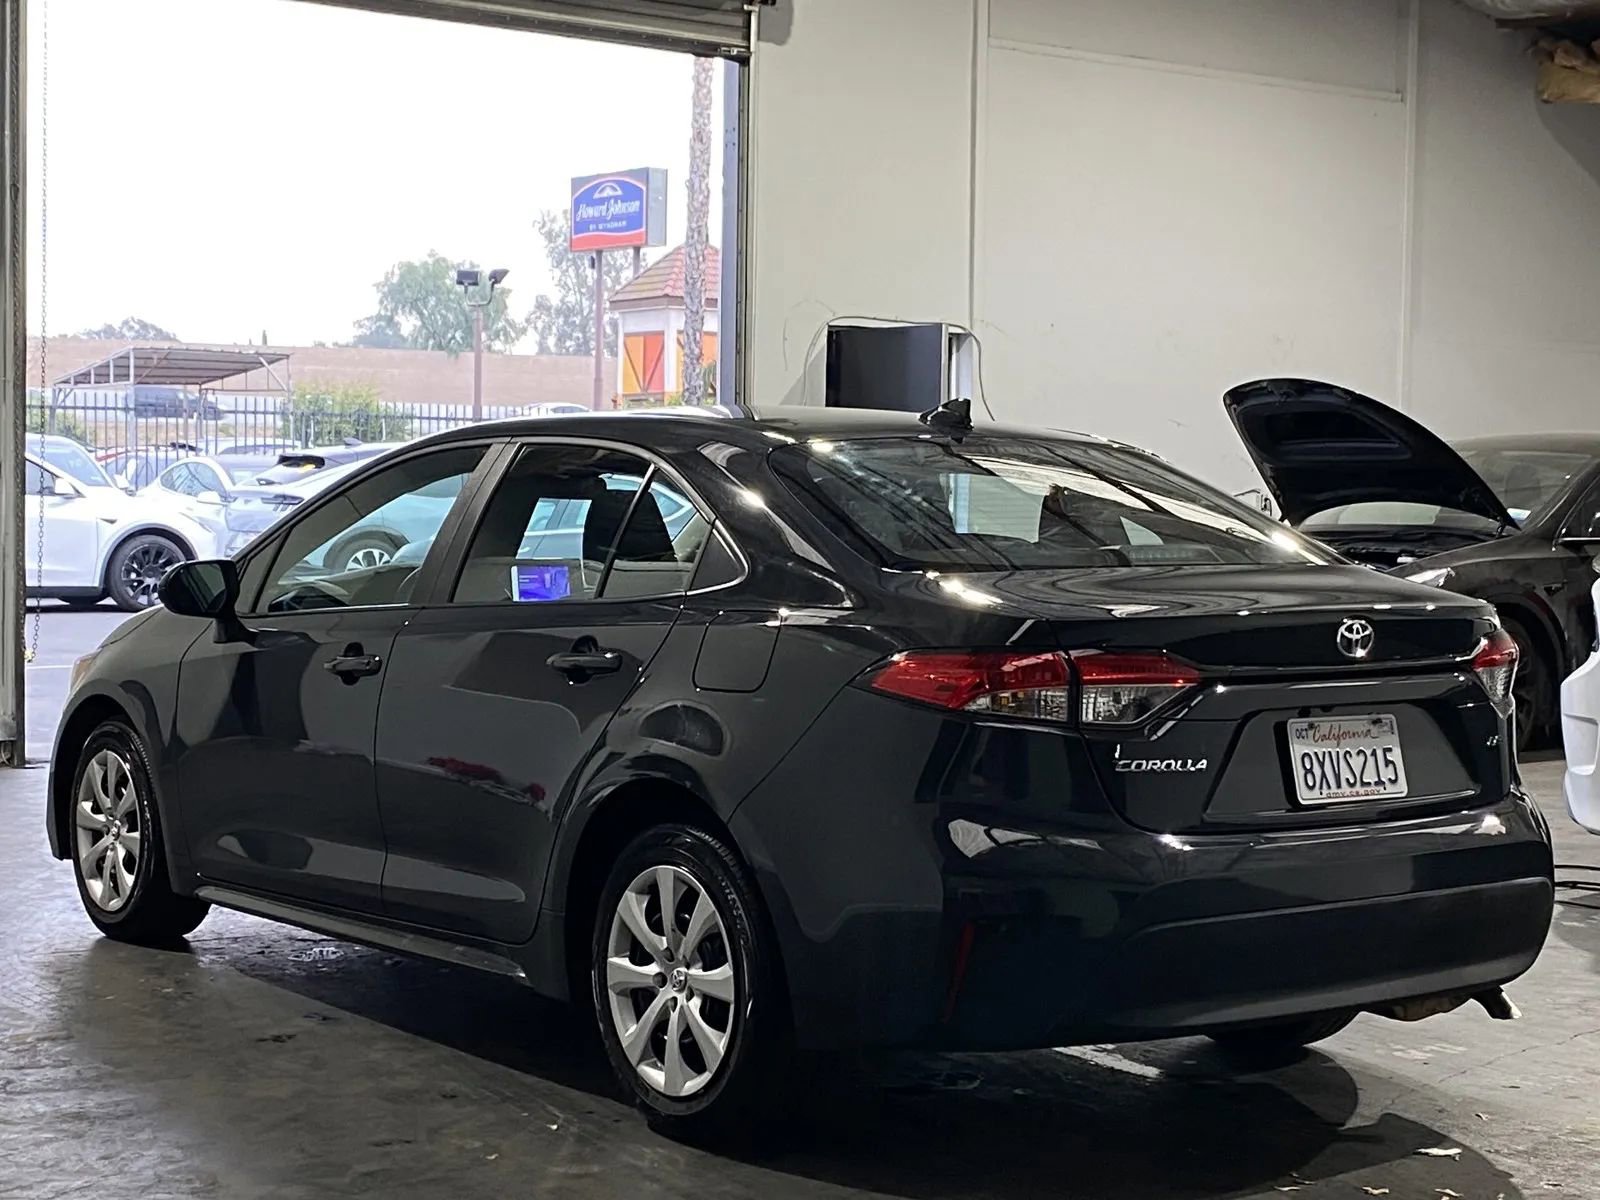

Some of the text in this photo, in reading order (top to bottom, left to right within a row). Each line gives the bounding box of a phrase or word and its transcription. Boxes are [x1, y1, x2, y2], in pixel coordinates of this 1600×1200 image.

[576, 198, 640, 222] Howard Johnson
[1295, 728, 1309, 740] OCT
[1312, 724, 1380, 747] California
[1114, 758, 1208, 772] COROLLA
[1300, 747, 1399, 791] 8XVS215
